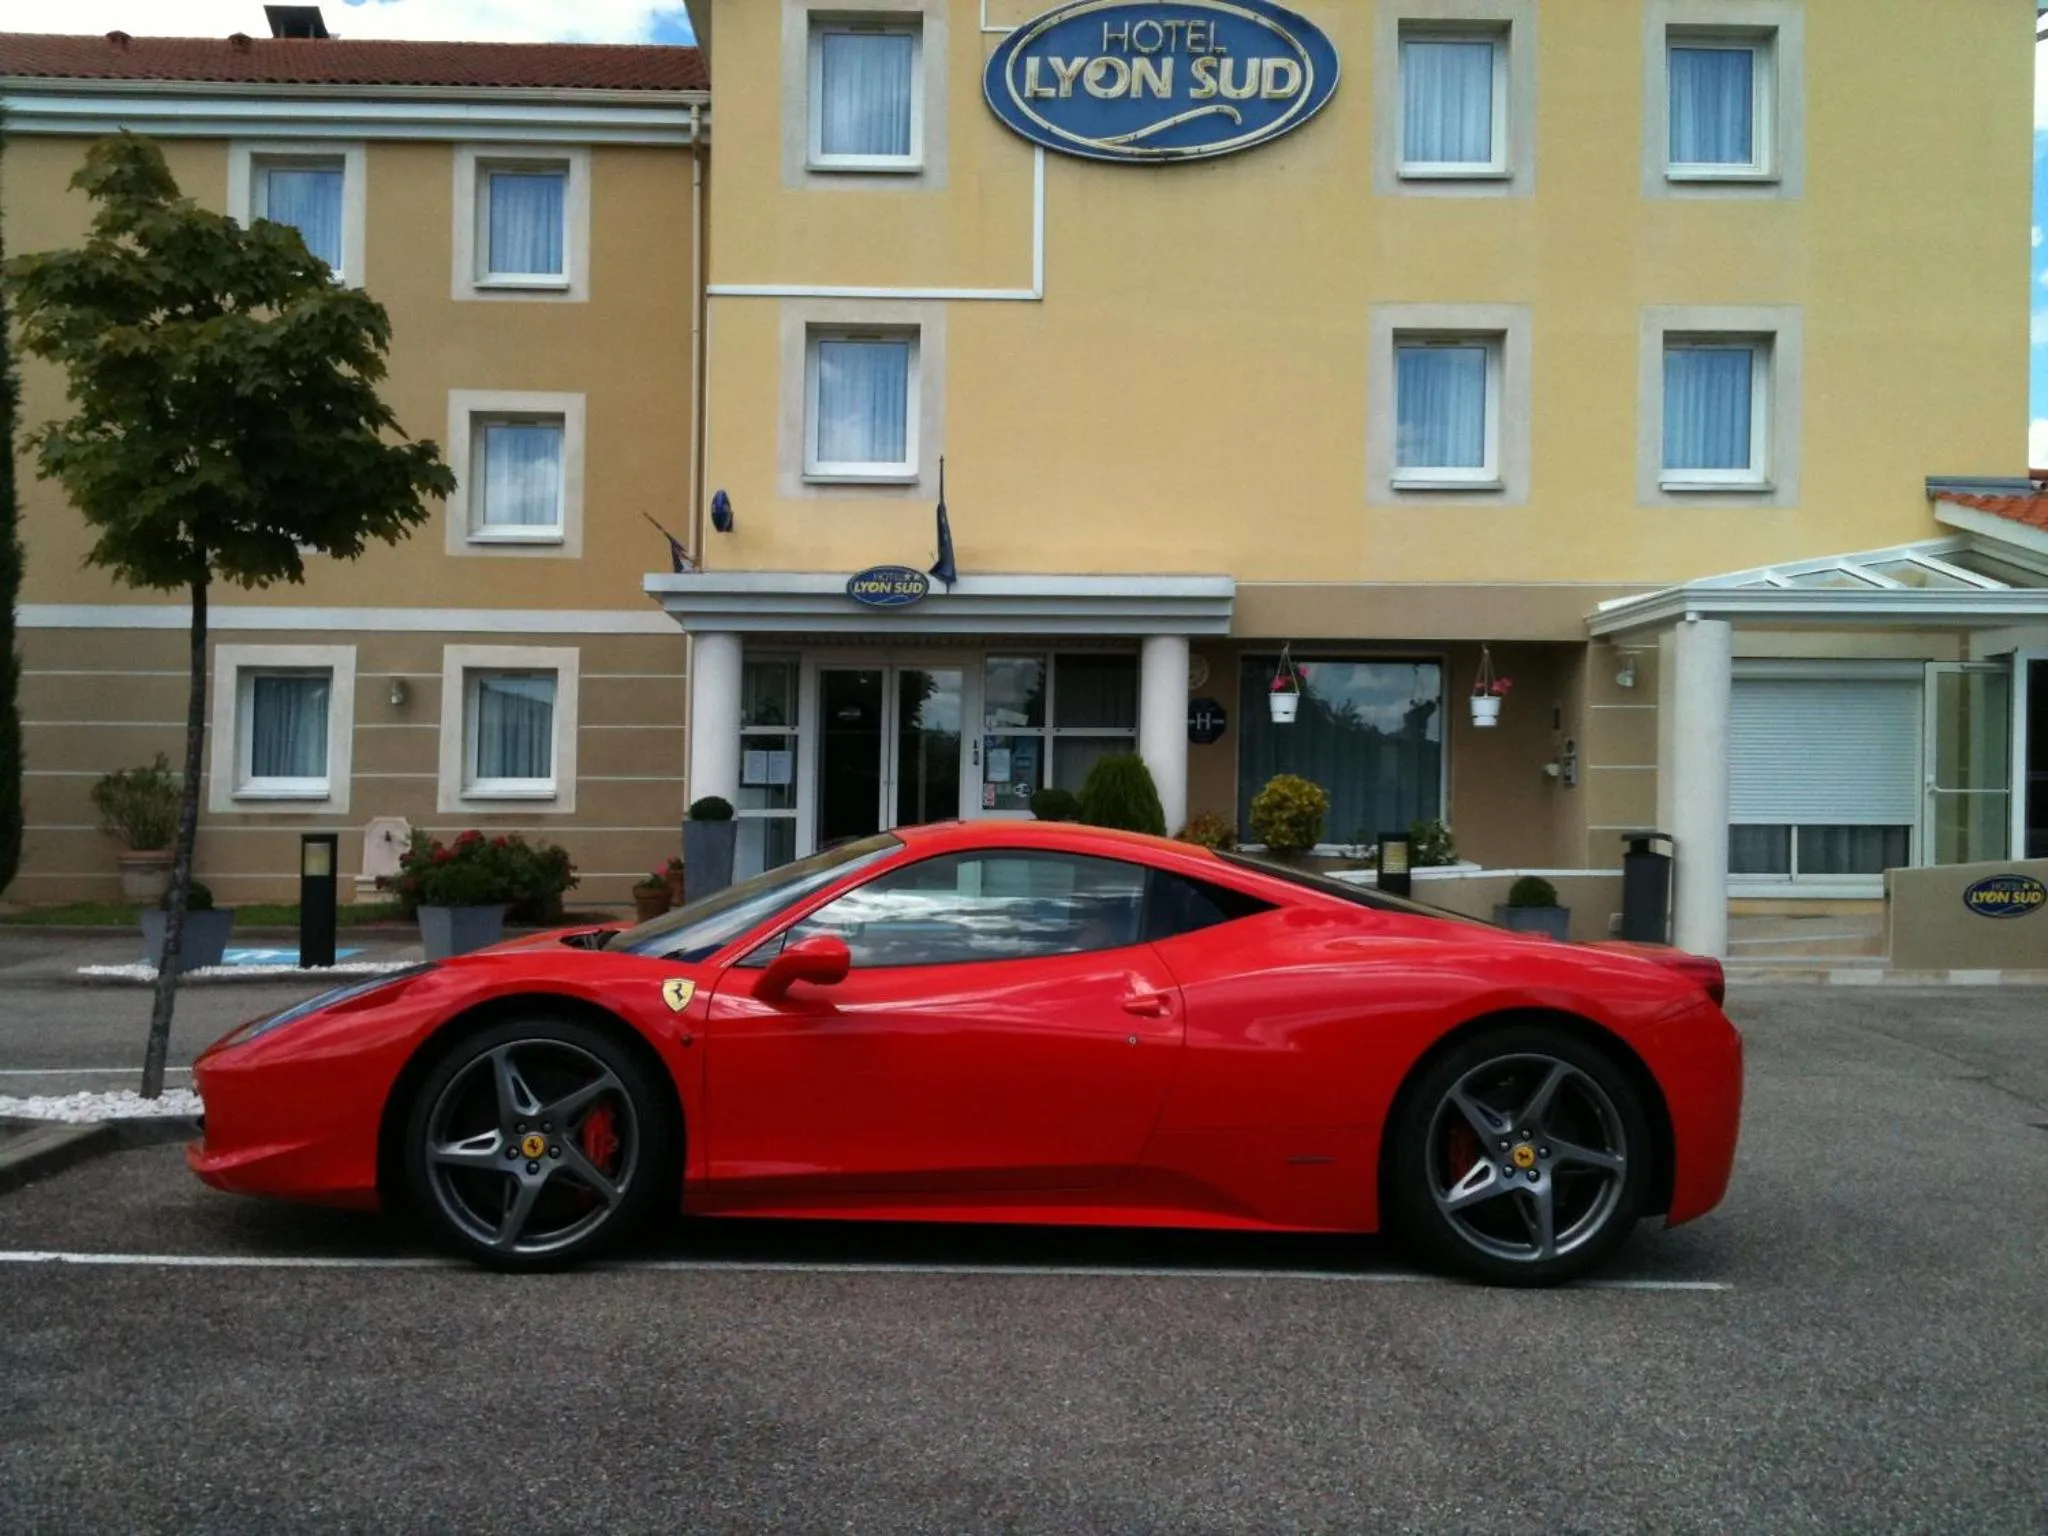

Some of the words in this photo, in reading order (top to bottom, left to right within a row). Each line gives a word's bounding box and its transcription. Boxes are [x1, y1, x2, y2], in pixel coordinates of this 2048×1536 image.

[1102, 20, 1227, 52] HOTEL
[1024, 56, 1174, 98] LYON
[1189, 56, 1302, 98] SUD
[854, 582, 891, 593] LYON
[894, 582, 923, 593] SUD
[1972, 891, 2009, 904] LYON
[2012, 891, 2041, 904] SUD
